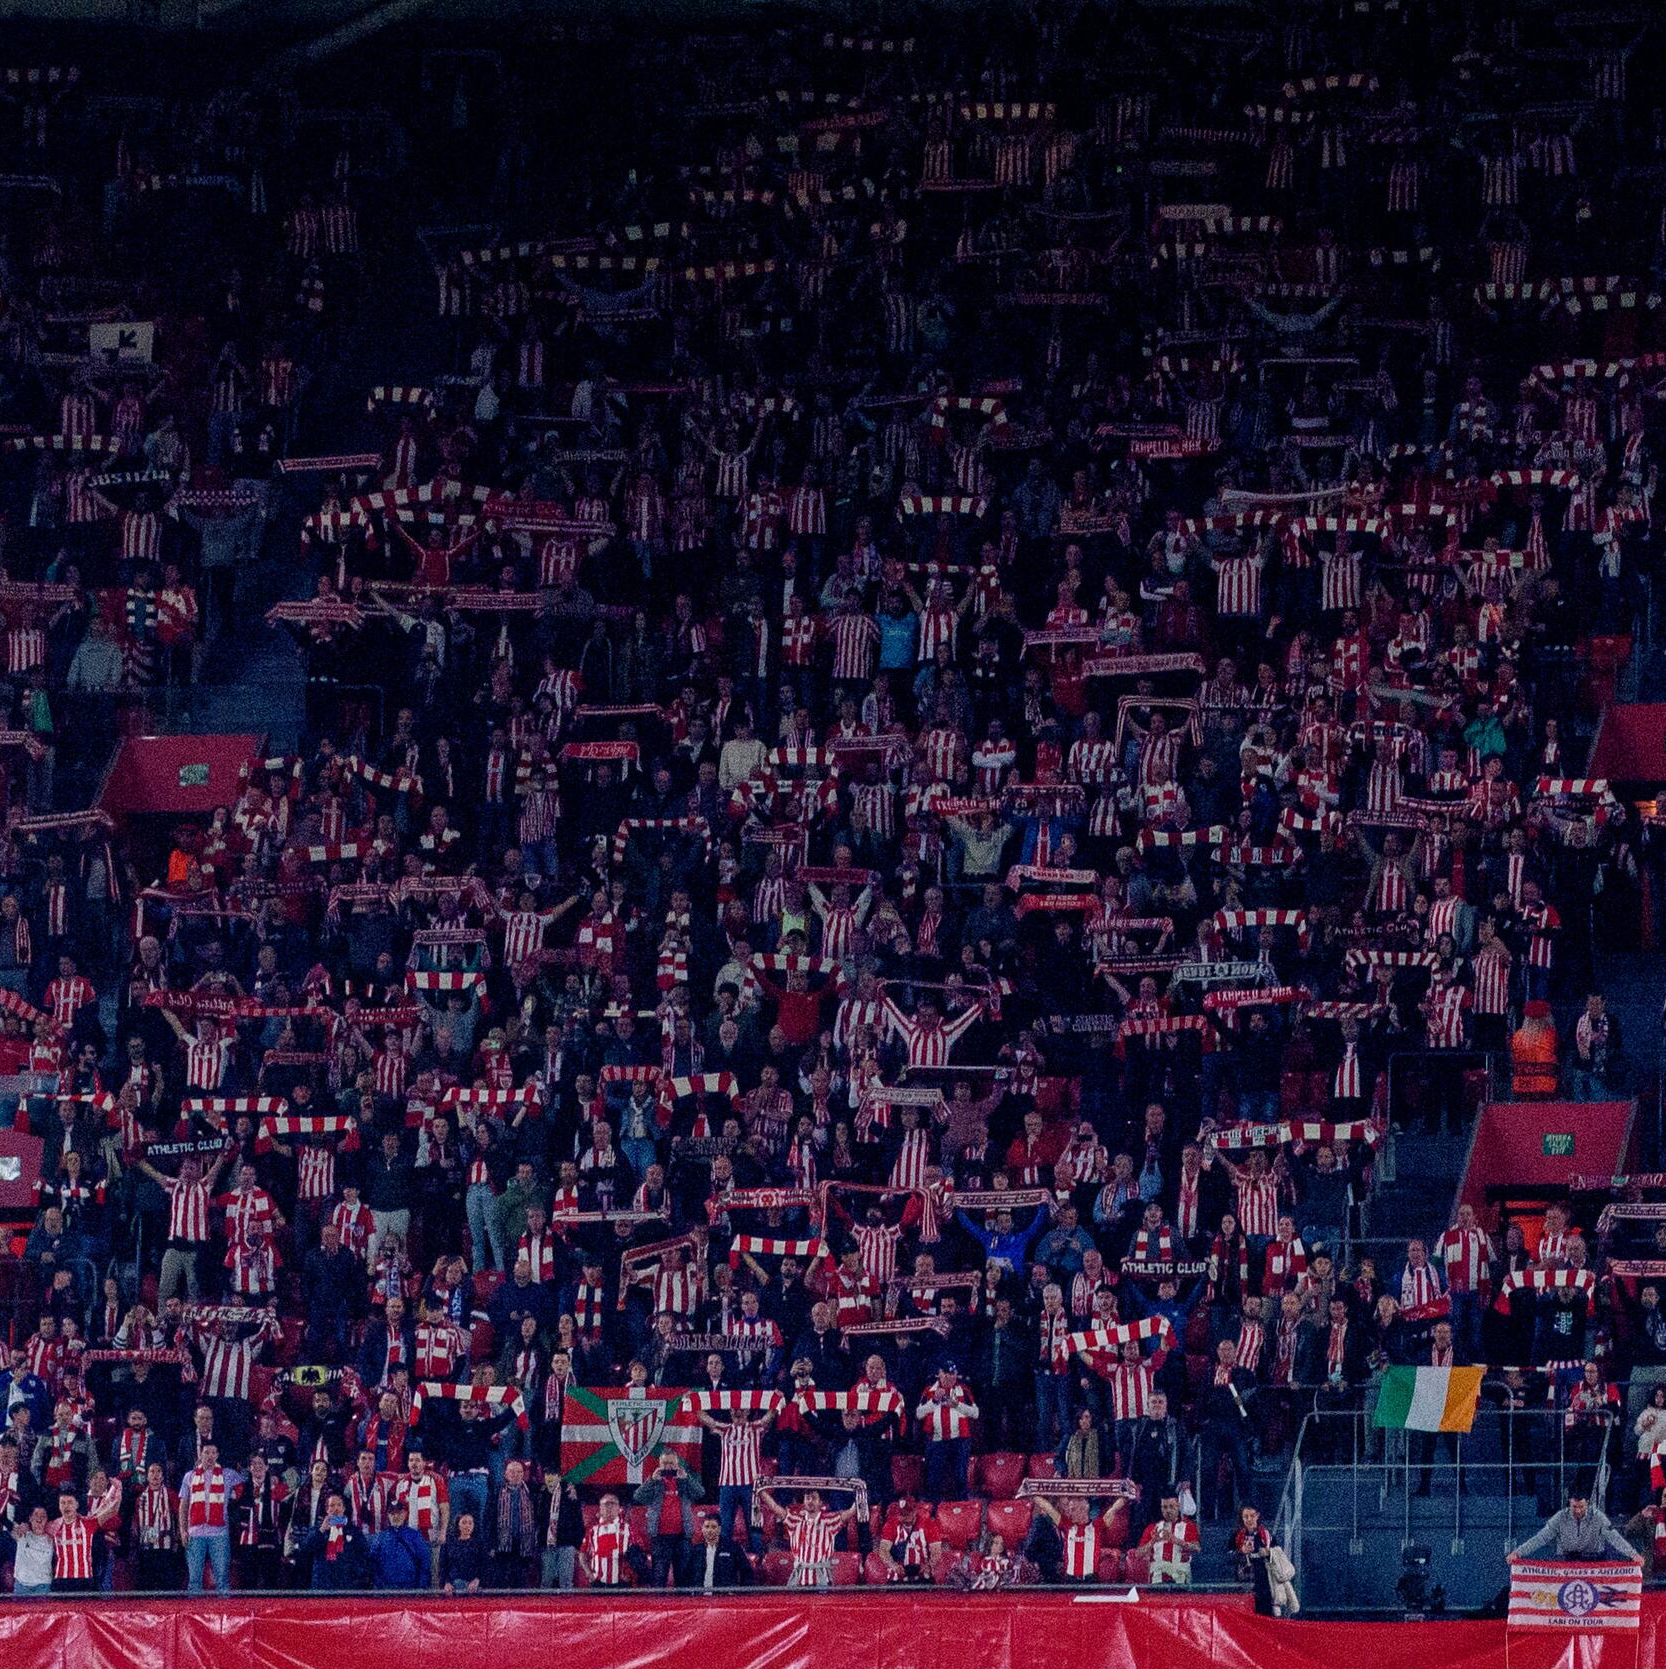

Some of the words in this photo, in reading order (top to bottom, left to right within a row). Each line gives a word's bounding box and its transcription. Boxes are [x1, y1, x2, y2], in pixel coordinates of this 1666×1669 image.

[147, 1143, 195, 1157] ATHLETIC
[198, 1140, 222, 1152] CLUB
[1122, 1262, 1174, 1275] ATHLETIC
[1178, 1262, 1206, 1274] CLUB
